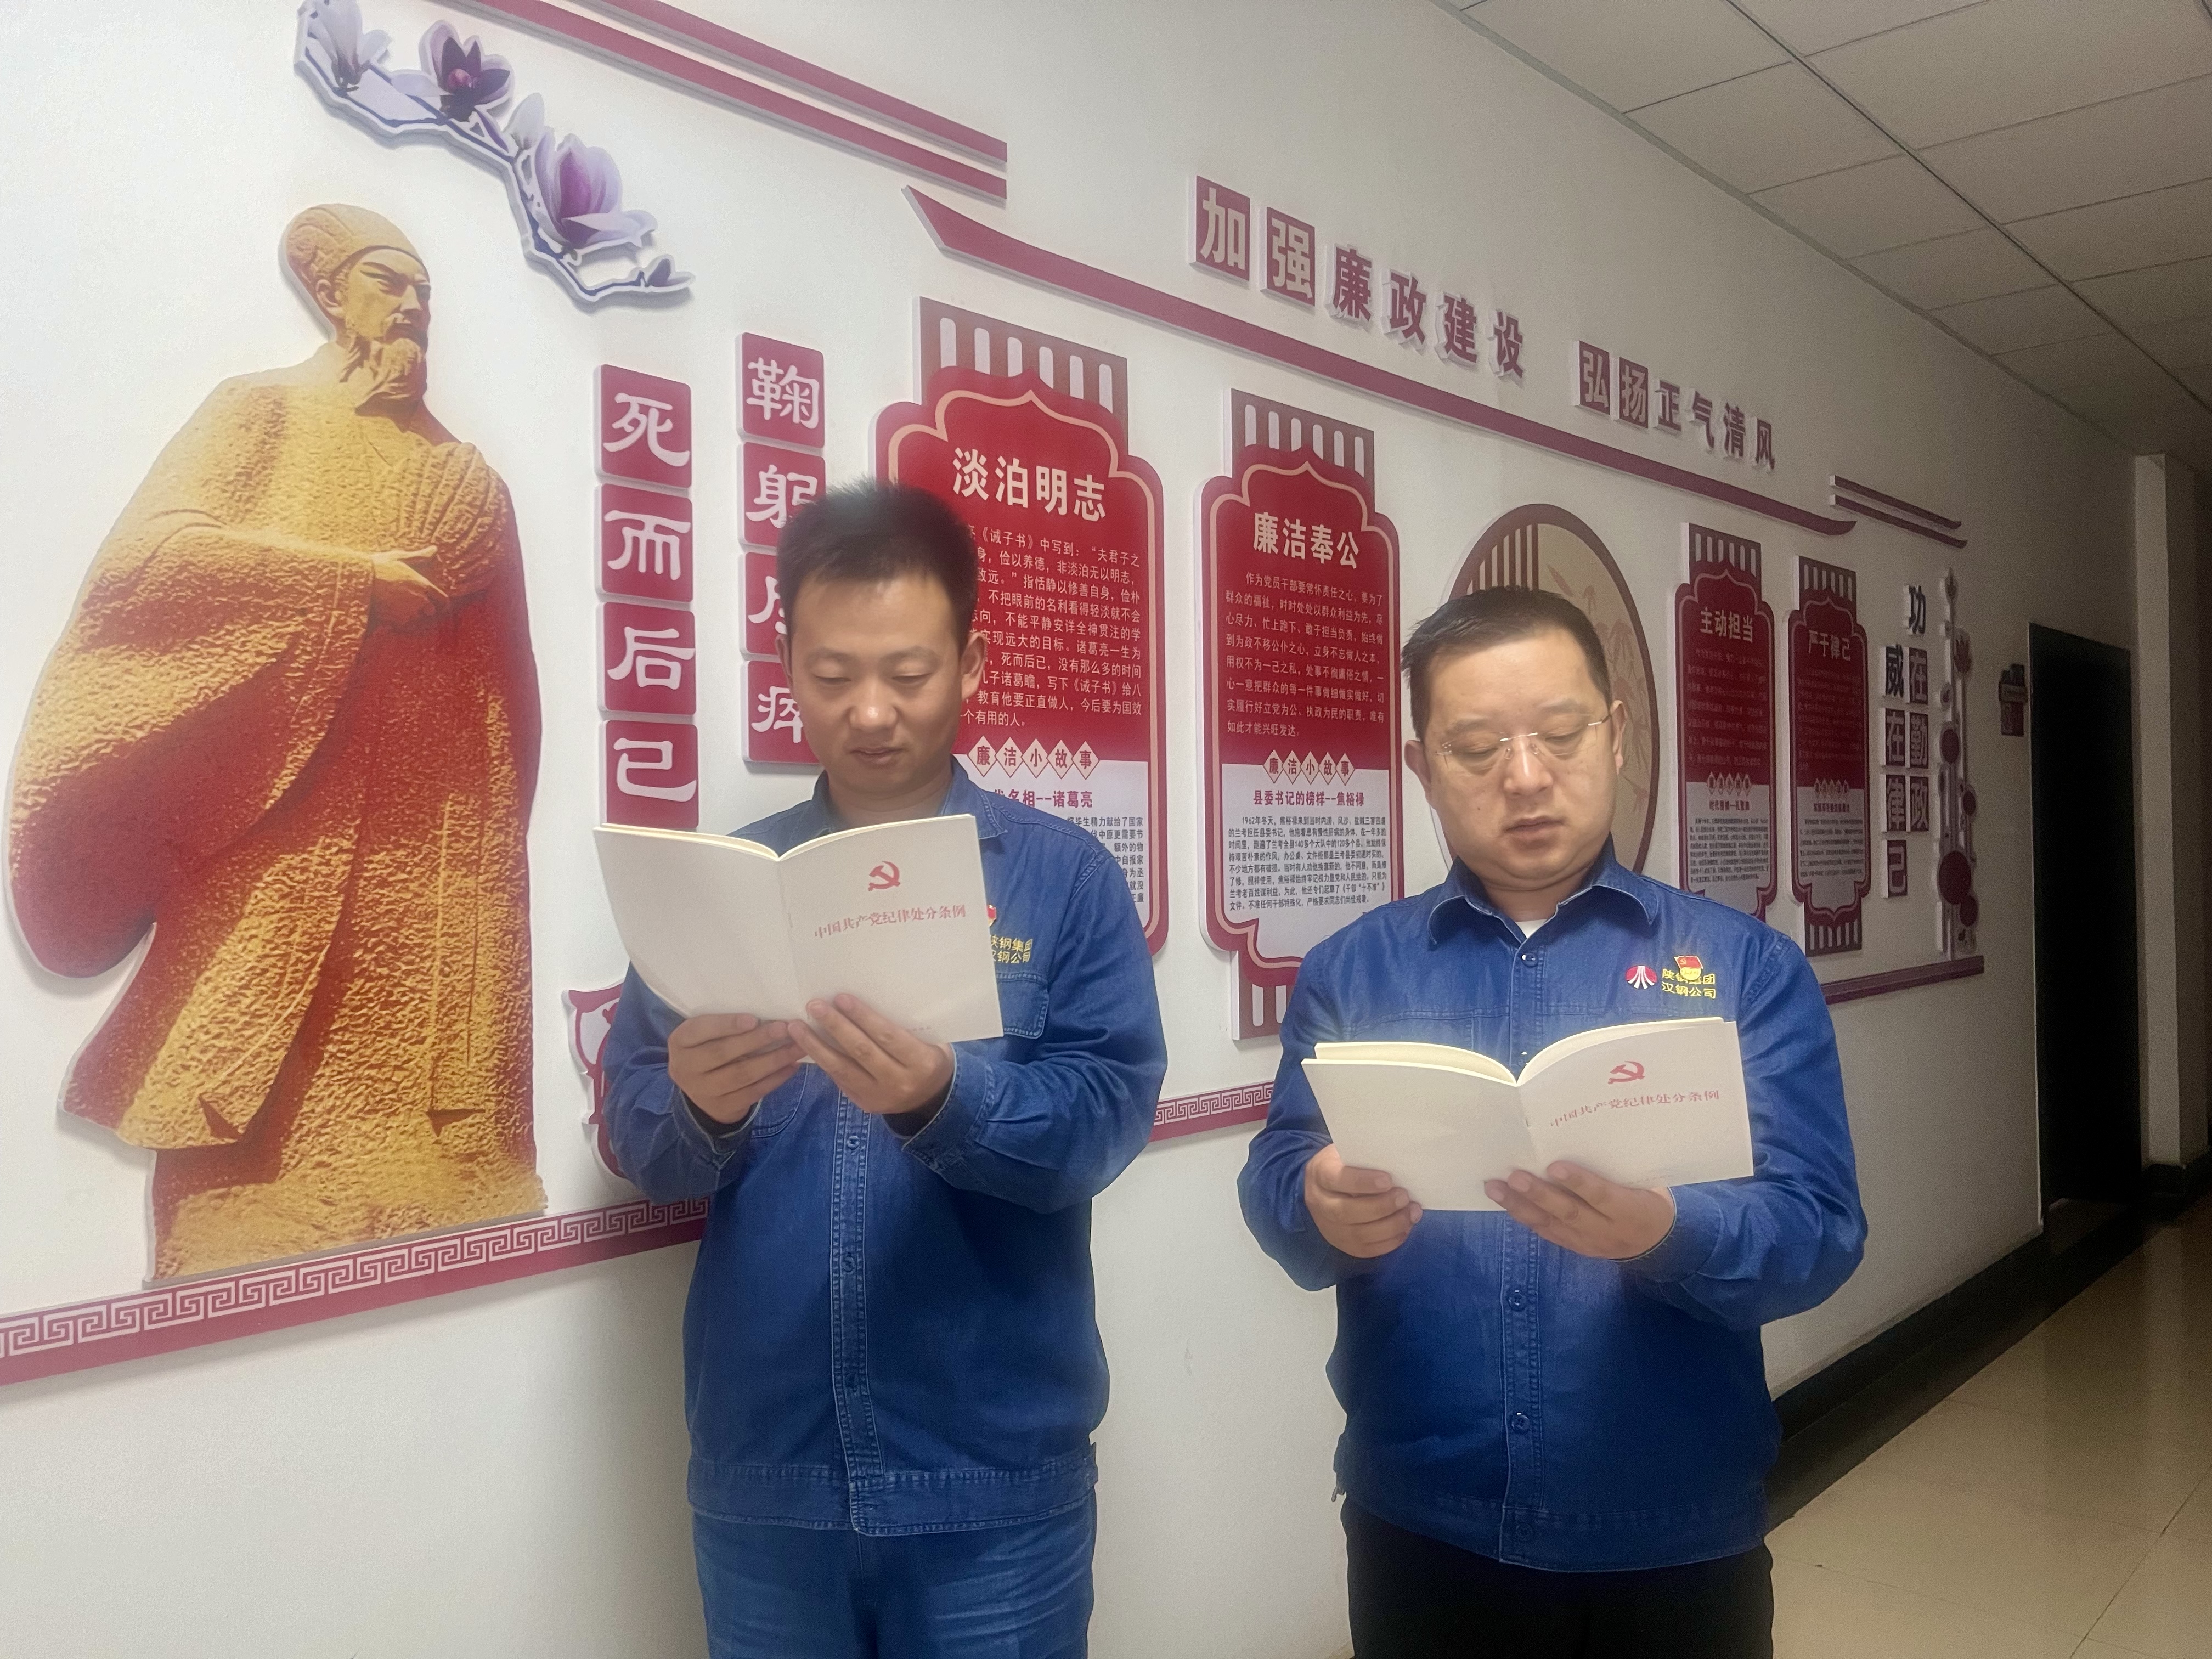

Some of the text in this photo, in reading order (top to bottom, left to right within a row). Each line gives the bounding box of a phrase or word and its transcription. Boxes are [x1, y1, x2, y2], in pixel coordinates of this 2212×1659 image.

[1201, 187, 1775, 470] 加强廉政建设 弘扬正气清风
[952, 447, 1106, 522] 淡泊明志
[1253, 511, 1359, 569] 廉洁奉公
[603, 392, 697, 802] 死而后已
[1701, 607, 1753, 643] 主动担当
[961, 709, 1025, 727] 个有用的人。
[977, 746, 1092, 769] 廉洁小故事
[1269, 757, 1350, 777] 廉洁小故事
[815, 905, 966, 939] 中国共产党纪律处分条例
[1662, 981, 1716, 1000] 汉钢公司
[1550, 1090, 1719, 1127] 中国共产党纪律处分条例
